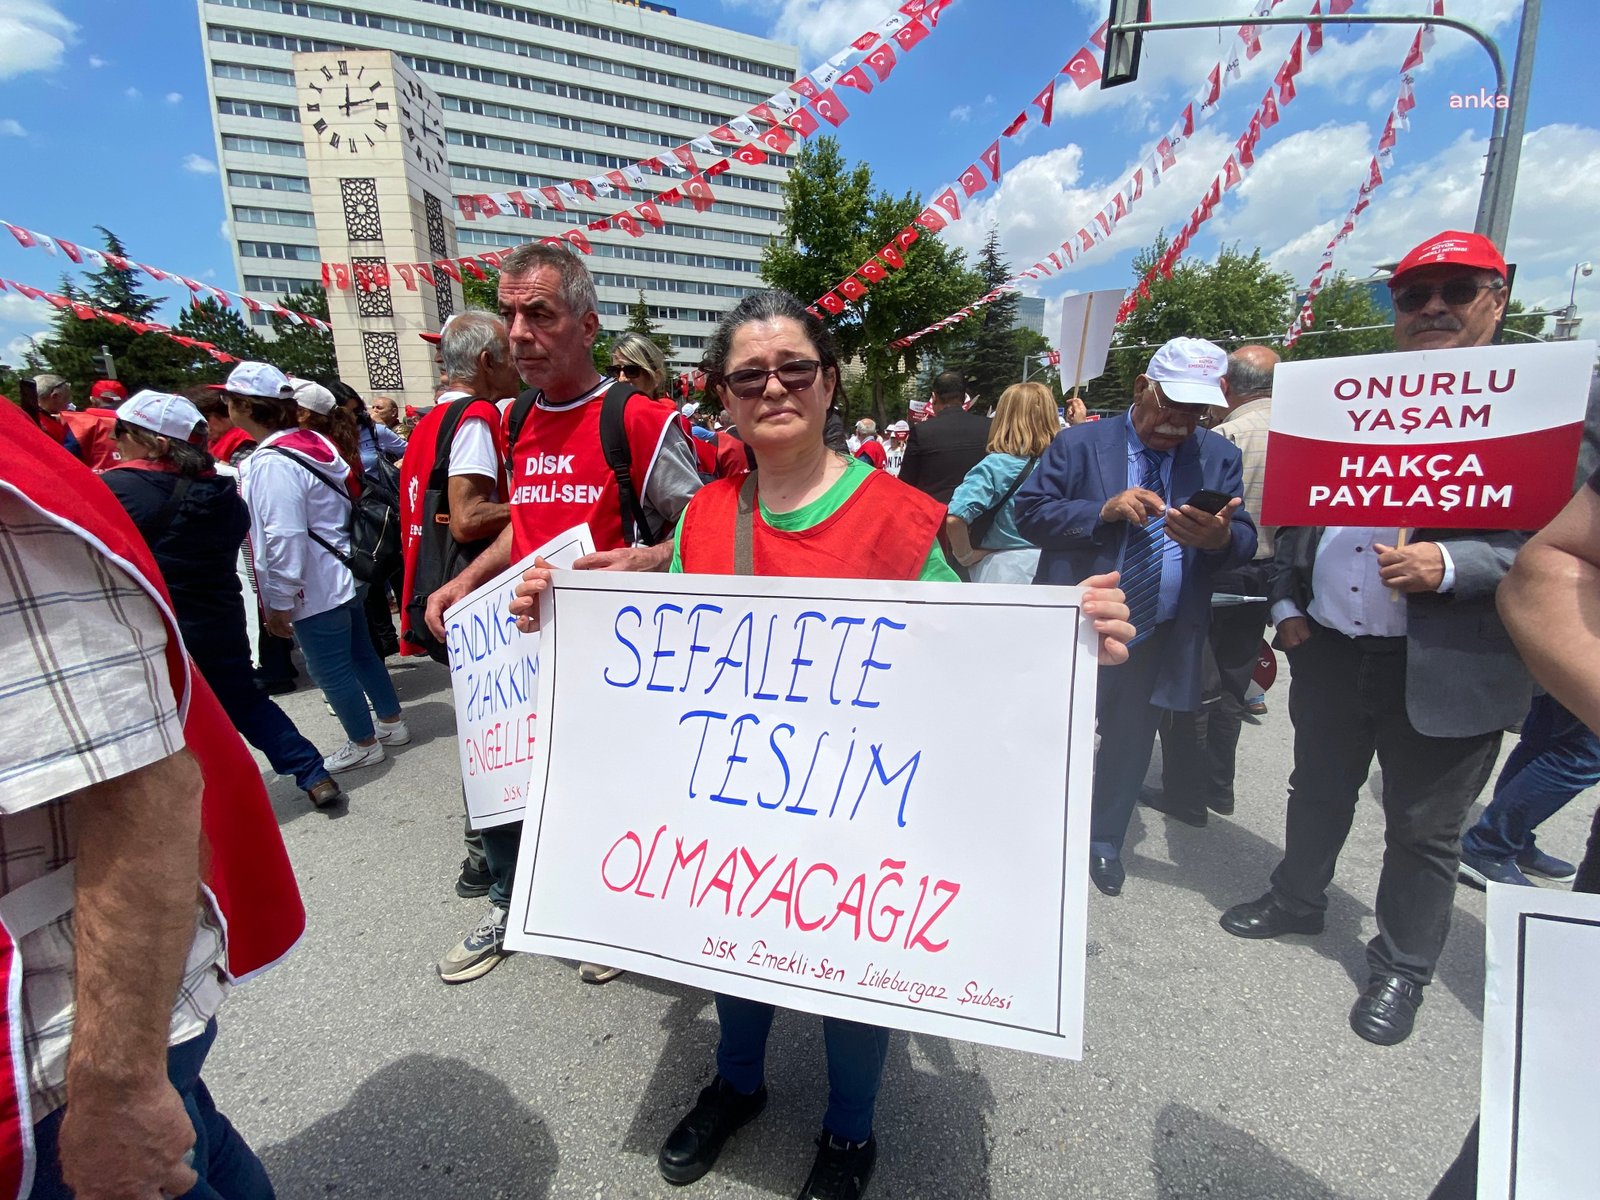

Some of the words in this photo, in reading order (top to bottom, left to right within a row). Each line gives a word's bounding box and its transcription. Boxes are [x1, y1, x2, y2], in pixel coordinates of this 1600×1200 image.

[1333, 368, 1516, 401] ONURLU
[1347, 404, 1492, 434] YAŞAM
[525, 451, 575, 476] DİSK
[1339, 454, 1484, 481] HAKÇA
[510, 480, 604, 505] EEKLİ-SEN
[1308, 485, 1513, 511] PAYLAŞIM
[604, 603, 907, 708] SEFALETE
[679, 710, 921, 828] TESLİM
[602, 825, 961, 952] OLMAYACAĞIZ
[702, 936, 738, 961] DİSK
[747, 940, 846, 982] Emekli-Sen
